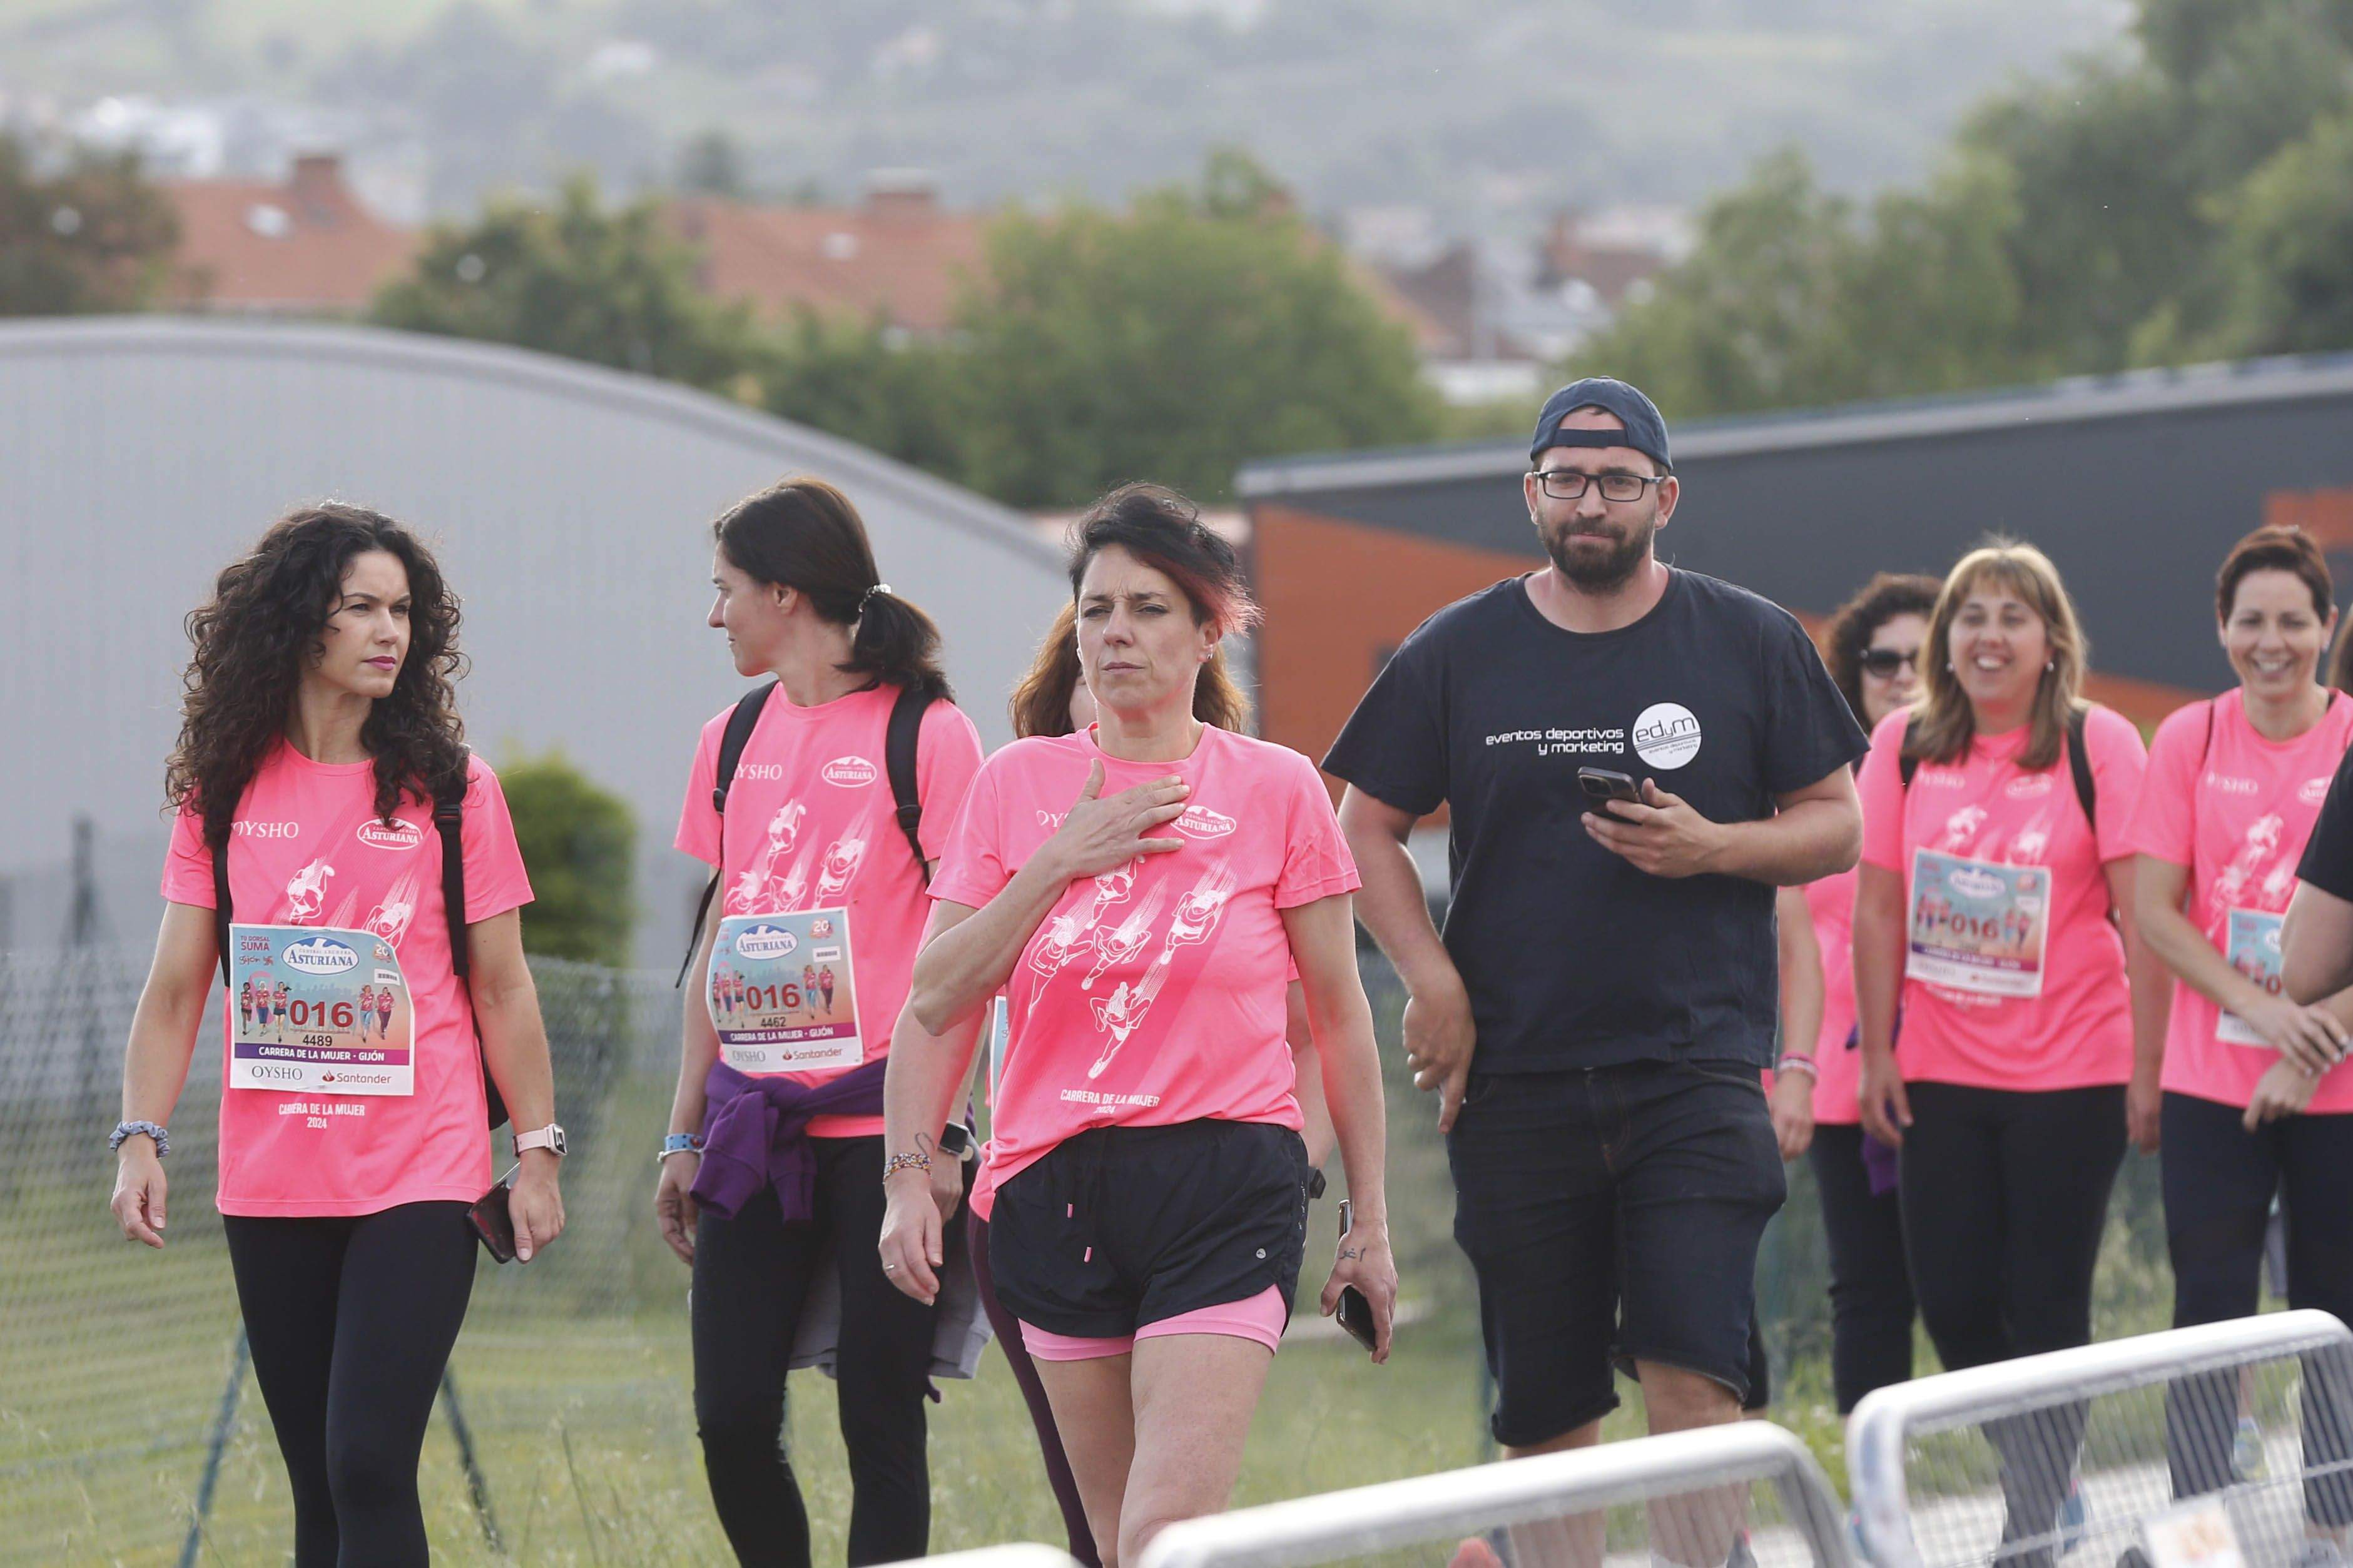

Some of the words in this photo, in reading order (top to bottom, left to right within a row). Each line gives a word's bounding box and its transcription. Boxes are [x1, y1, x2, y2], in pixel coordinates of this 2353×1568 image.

[1485, 729, 1542, 746] eventos
[1545, 727, 1625, 742] deportivos
[1538, 743, 1548, 756] y
[1551, 741, 1625, 754] marketing
[736, 764, 782, 780] YSHO
[826, 766, 872, 779] ASTURIANA
[1174, 816, 1232, 832] ASTURIANA
[363, 827, 419, 844] ASTURIANA
[241, 941, 270, 951] SUMA
[739, 939, 793, 953] ASTURIANA
[288, 949, 353, 966] ASTURIANA
[746, 983, 801, 1010] 016
[290, 999, 353, 1028] 016
[761, 1016, 786, 1028] 4462
[303, 1034, 333, 1046] 4489
[768, 1031, 778, 1040] LA
[778, 1029, 803, 1039] MUJER
[258, 1046, 295, 1057] CARRERA
[297, 1049, 307, 1058] DE
[308, 1051, 318, 1059] LA
[320, 1051, 350, 1060] MUJER
[358, 1050, 385, 1061] GIJÓN
[793, 1048, 843, 1060] Santander
[252, 1066, 303, 1081] OYSHO
[337, 1073, 393, 1084] Santander
[1060, 1089, 1100, 1105] CARRERA
[1102, 1093, 1114, 1105] DE
[1115, 1095, 1126, 1105] LA
[1127, 1095, 1160, 1107] MUJER
[310, 1103, 320, 1115] DE
[322, 1104, 333, 1115] LA
[335, 1103, 365, 1116] MUJER
[1093, 1105, 1116, 1115] 2024
[307, 1116, 327, 1128] 2024
